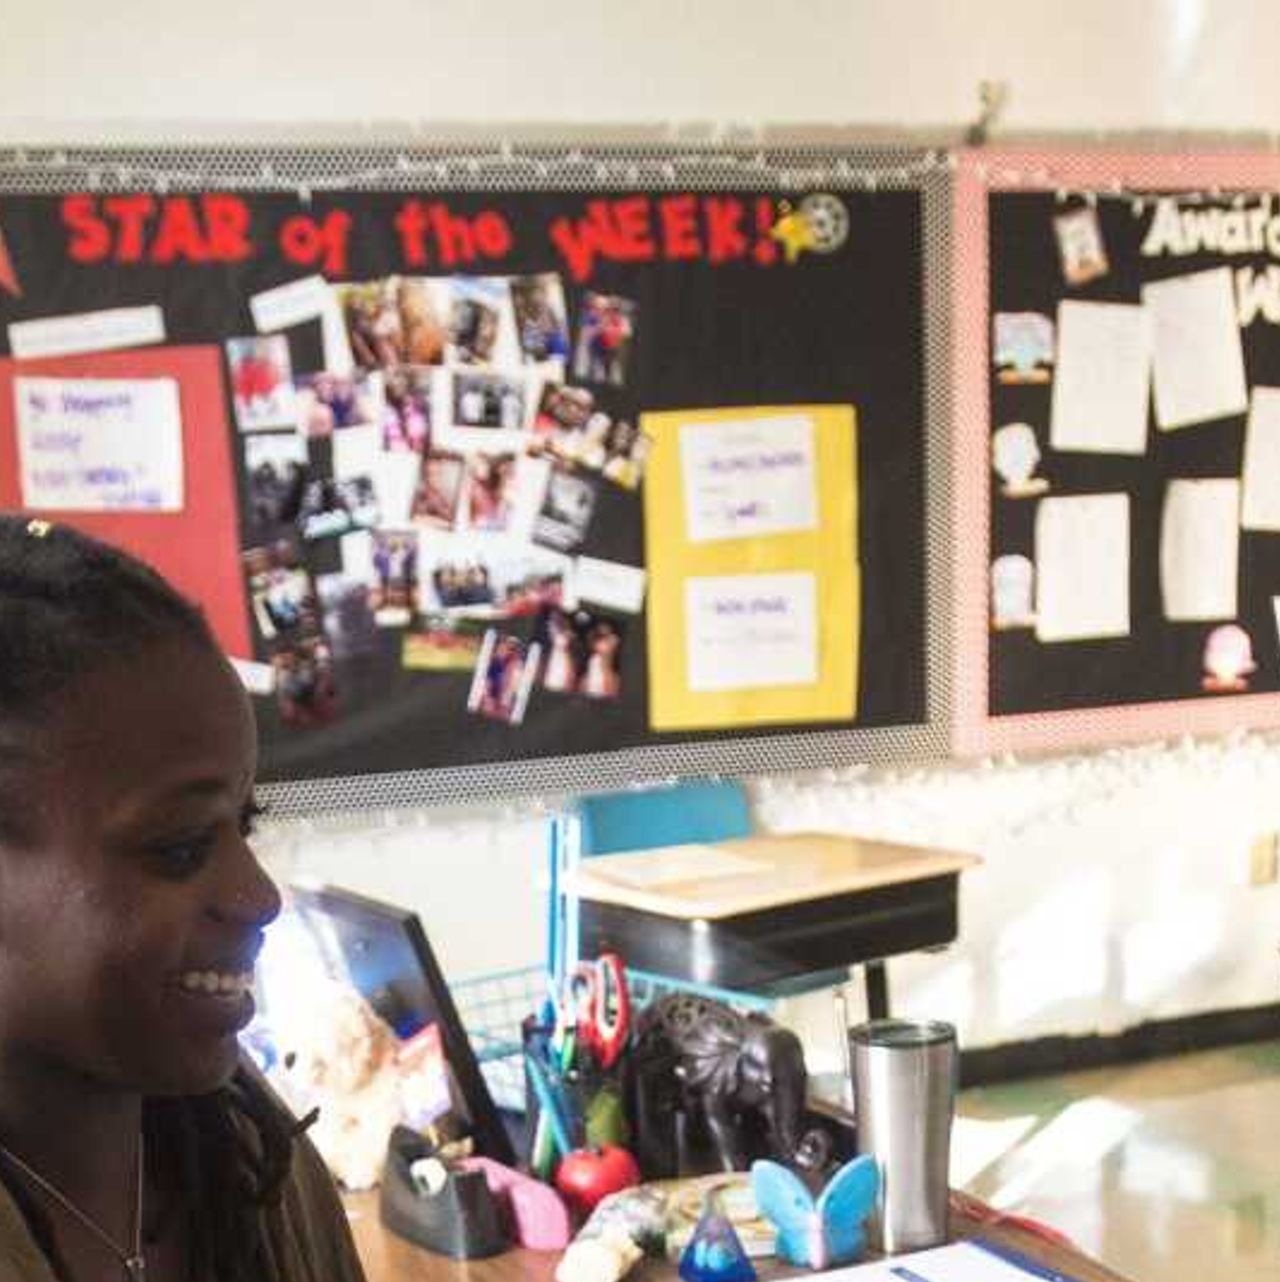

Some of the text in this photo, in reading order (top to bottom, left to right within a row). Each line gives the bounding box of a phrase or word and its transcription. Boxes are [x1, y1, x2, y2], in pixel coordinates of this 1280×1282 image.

[59, 191, 778, 284] STAR of the WEEK!
